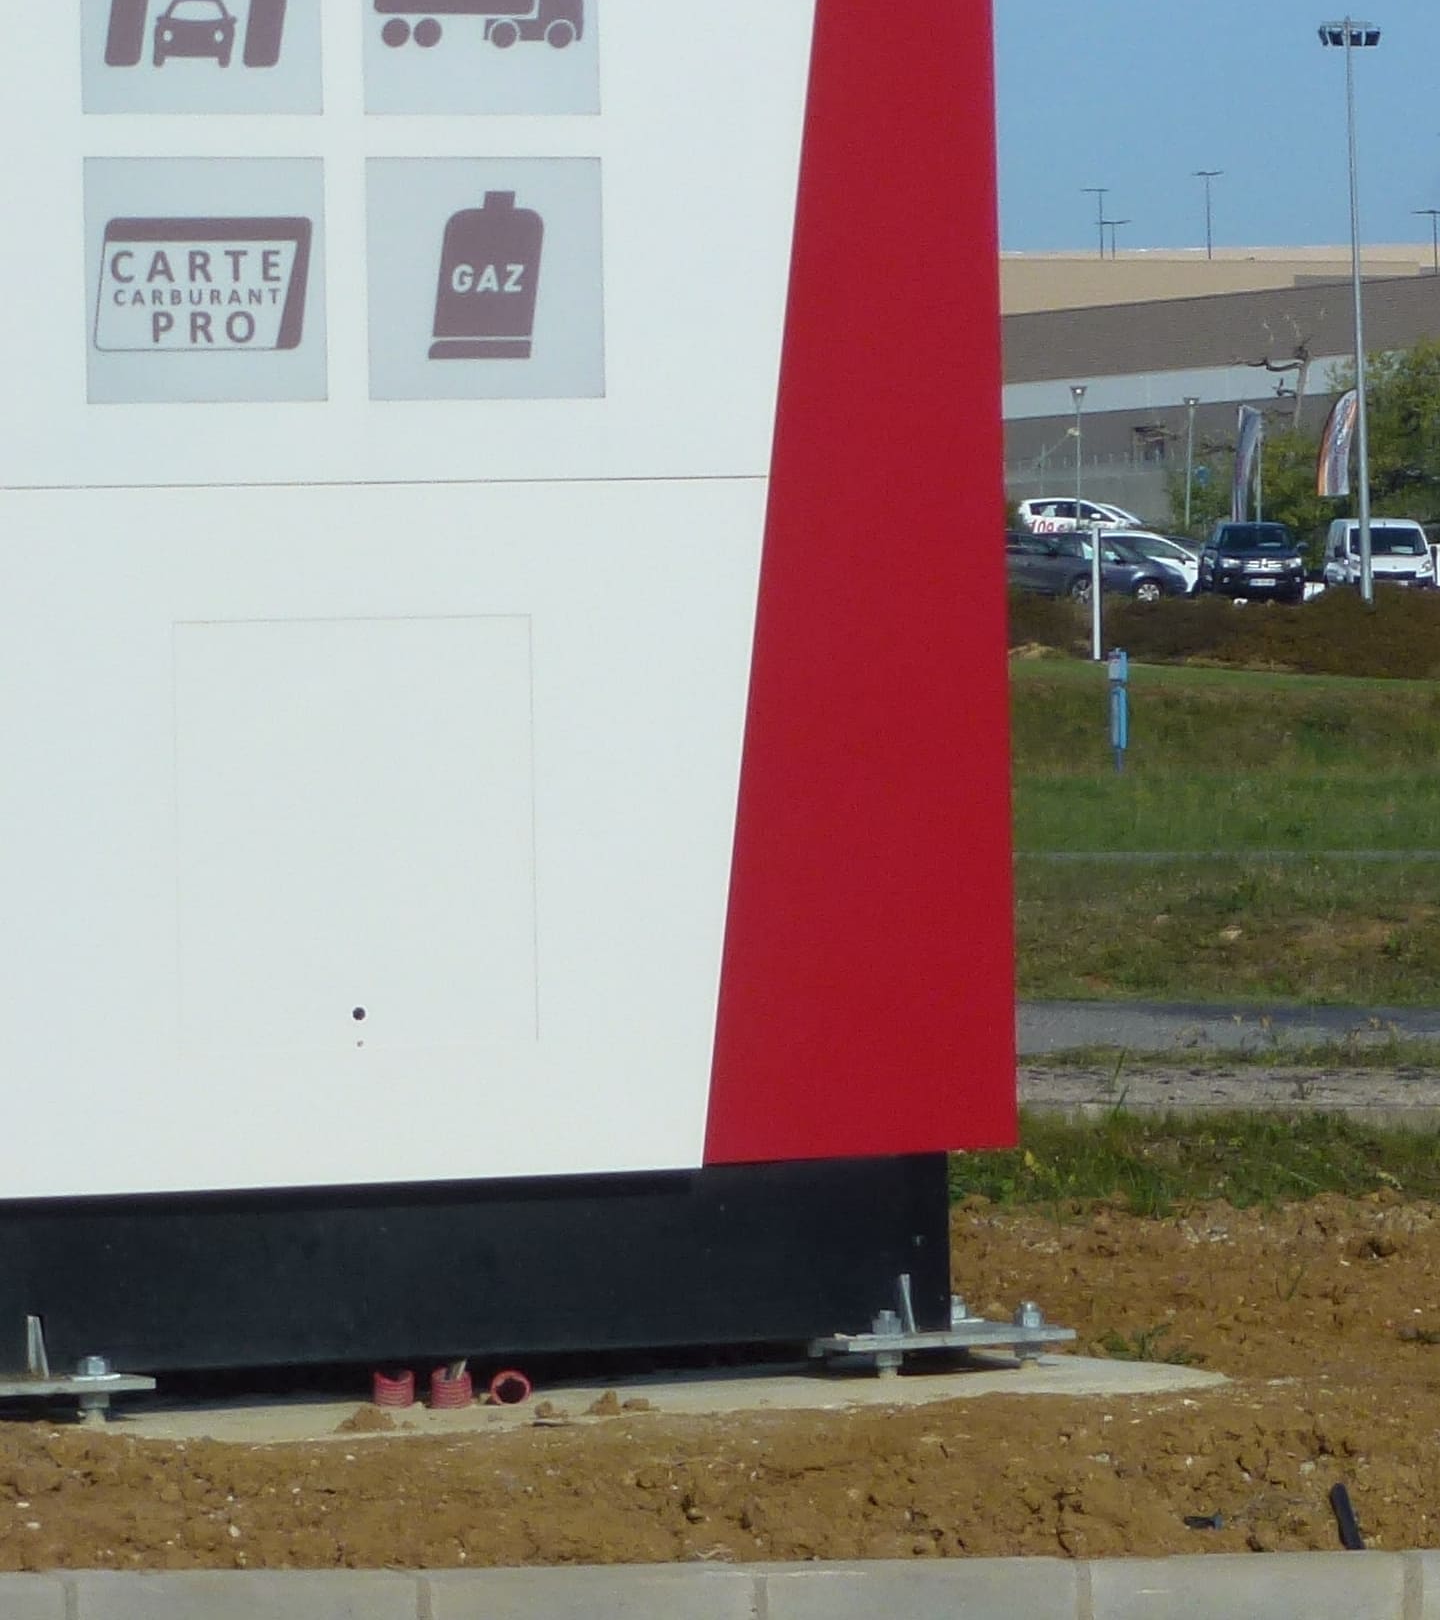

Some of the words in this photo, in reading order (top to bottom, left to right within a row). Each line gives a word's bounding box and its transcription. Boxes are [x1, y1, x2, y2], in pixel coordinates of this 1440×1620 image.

[110, 249, 282, 284] CARTE
[451, 262, 525, 294] GAZ
[113, 288, 281, 306] CARBURANT
[151, 310, 256, 344] PRO
